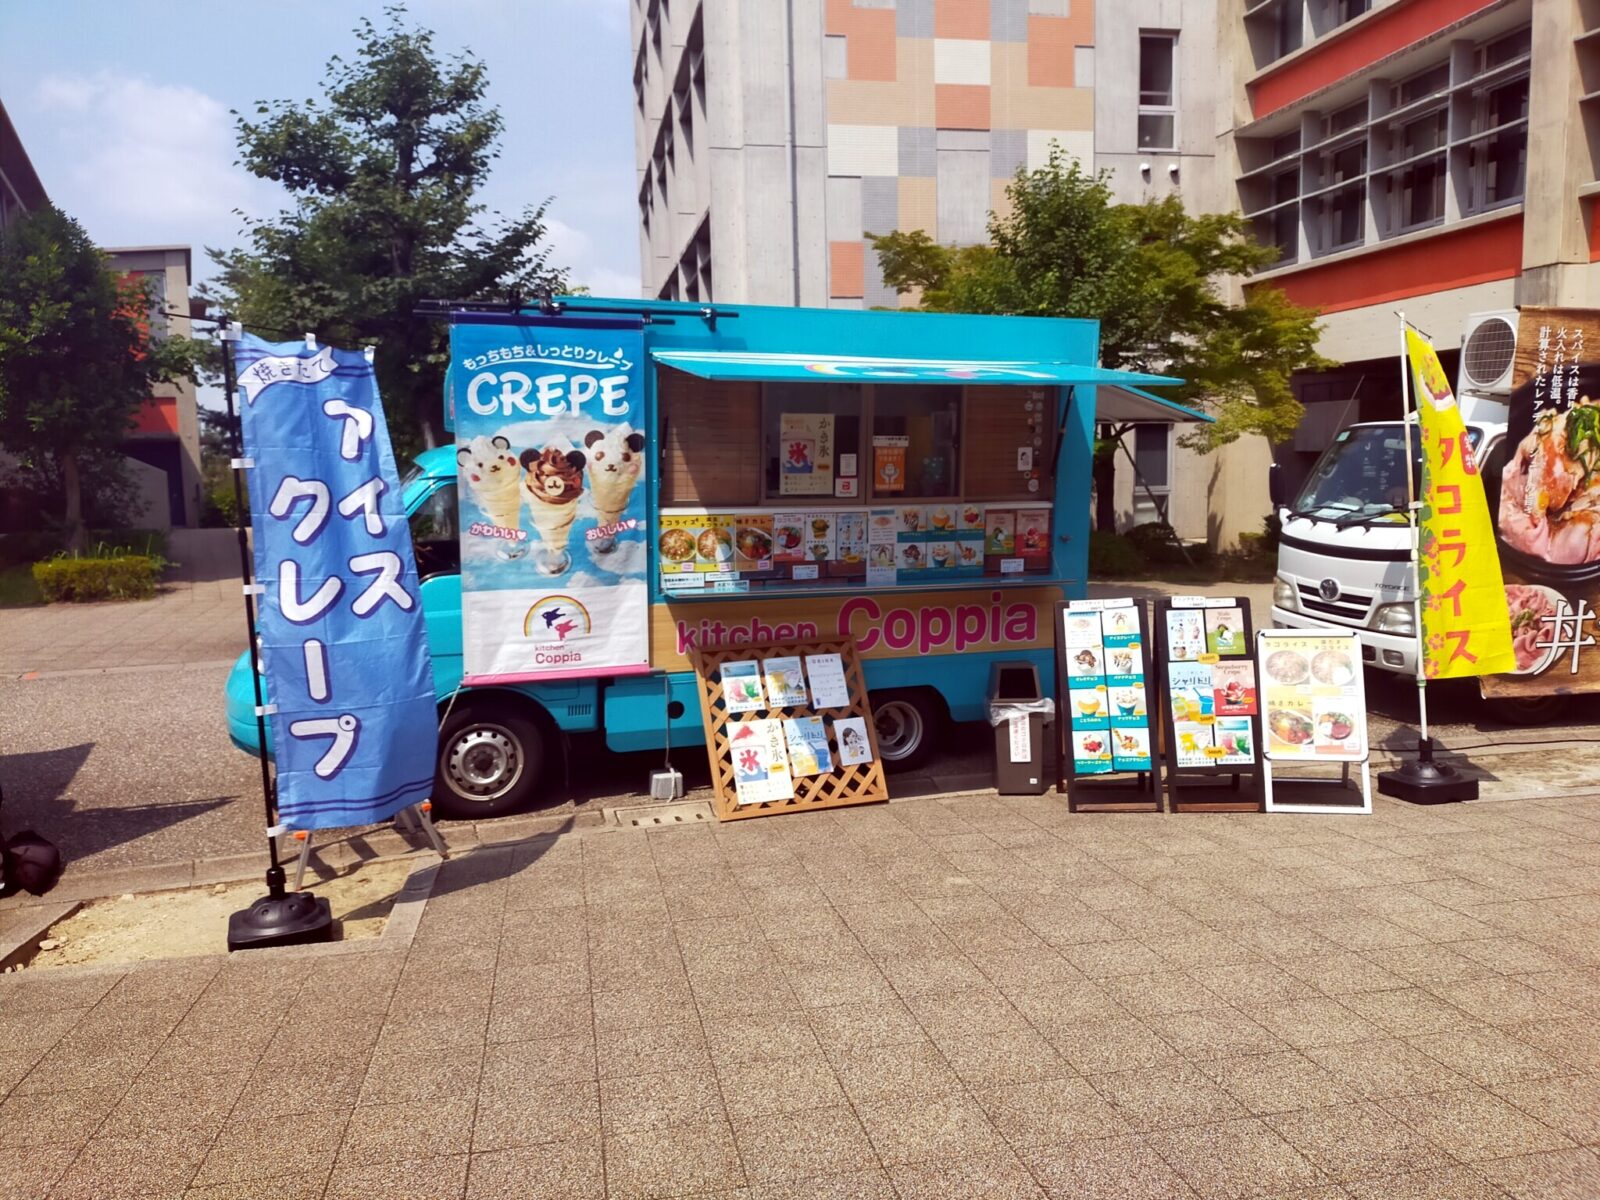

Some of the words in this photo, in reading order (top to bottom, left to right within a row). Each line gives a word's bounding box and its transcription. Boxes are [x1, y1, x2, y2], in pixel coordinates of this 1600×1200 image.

[253, 358, 332, 384] 焼きたて
[1549, 326, 1568, 404] 火入れは低温。
[467, 371, 630, 417] CREPE
[788, 441, 808, 465] 氷
[818, 417, 831, 458] かき氷
[322, 399, 414, 617] アイス
[470, 521, 518, 541] かわいい
[586, 520, 629, 541] おいしい
[1437, 436, 1478, 666] タコライス
[270, 475, 359, 779] クレープ
[677, 616, 818, 655] kitchen
[836, 591, 1038, 656] Coppia
[1533, 599, 1597, 675] 丼
[535, 651, 582, 664] Coppia
[739, 749, 760, 772] 氷
[767, 722, 784, 763] かき氷
